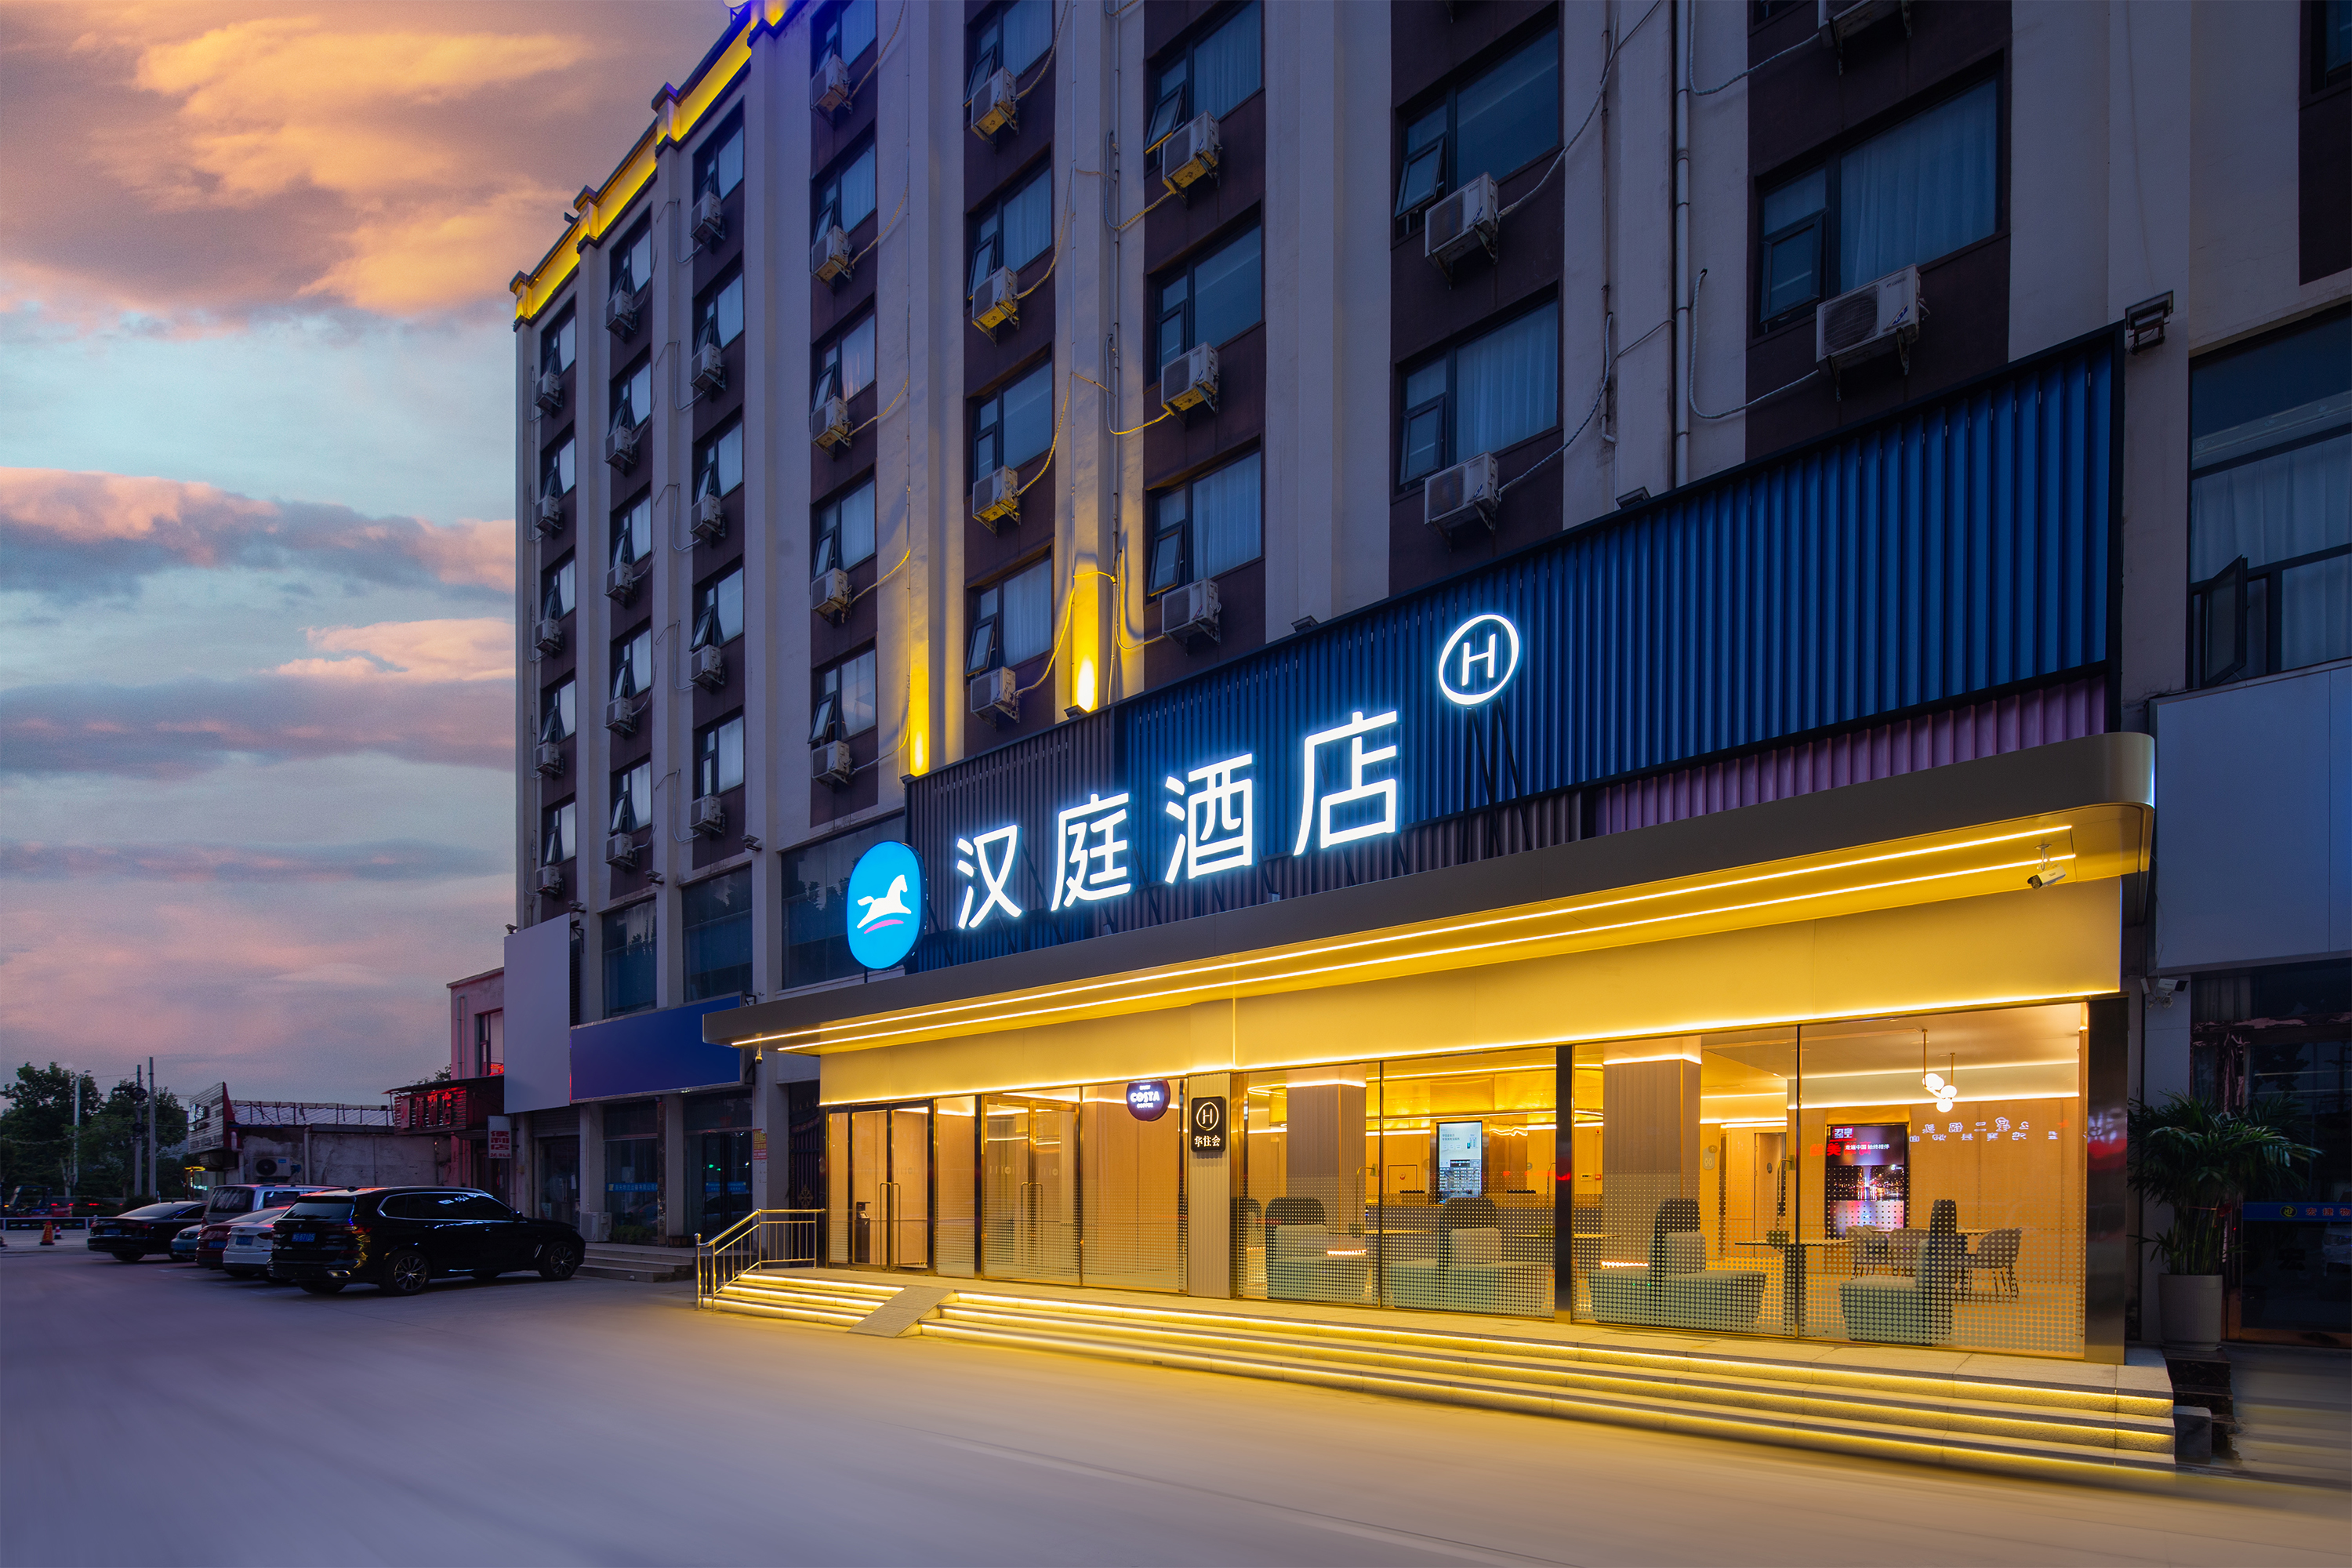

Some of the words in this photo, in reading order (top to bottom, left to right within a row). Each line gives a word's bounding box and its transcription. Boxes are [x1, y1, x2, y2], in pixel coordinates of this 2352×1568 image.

[956, 710, 1399, 931] 汉庭酒店
[1130, 1091, 1160, 1102] COSTA
[1194, 1134, 1221, 1148] 华住会
